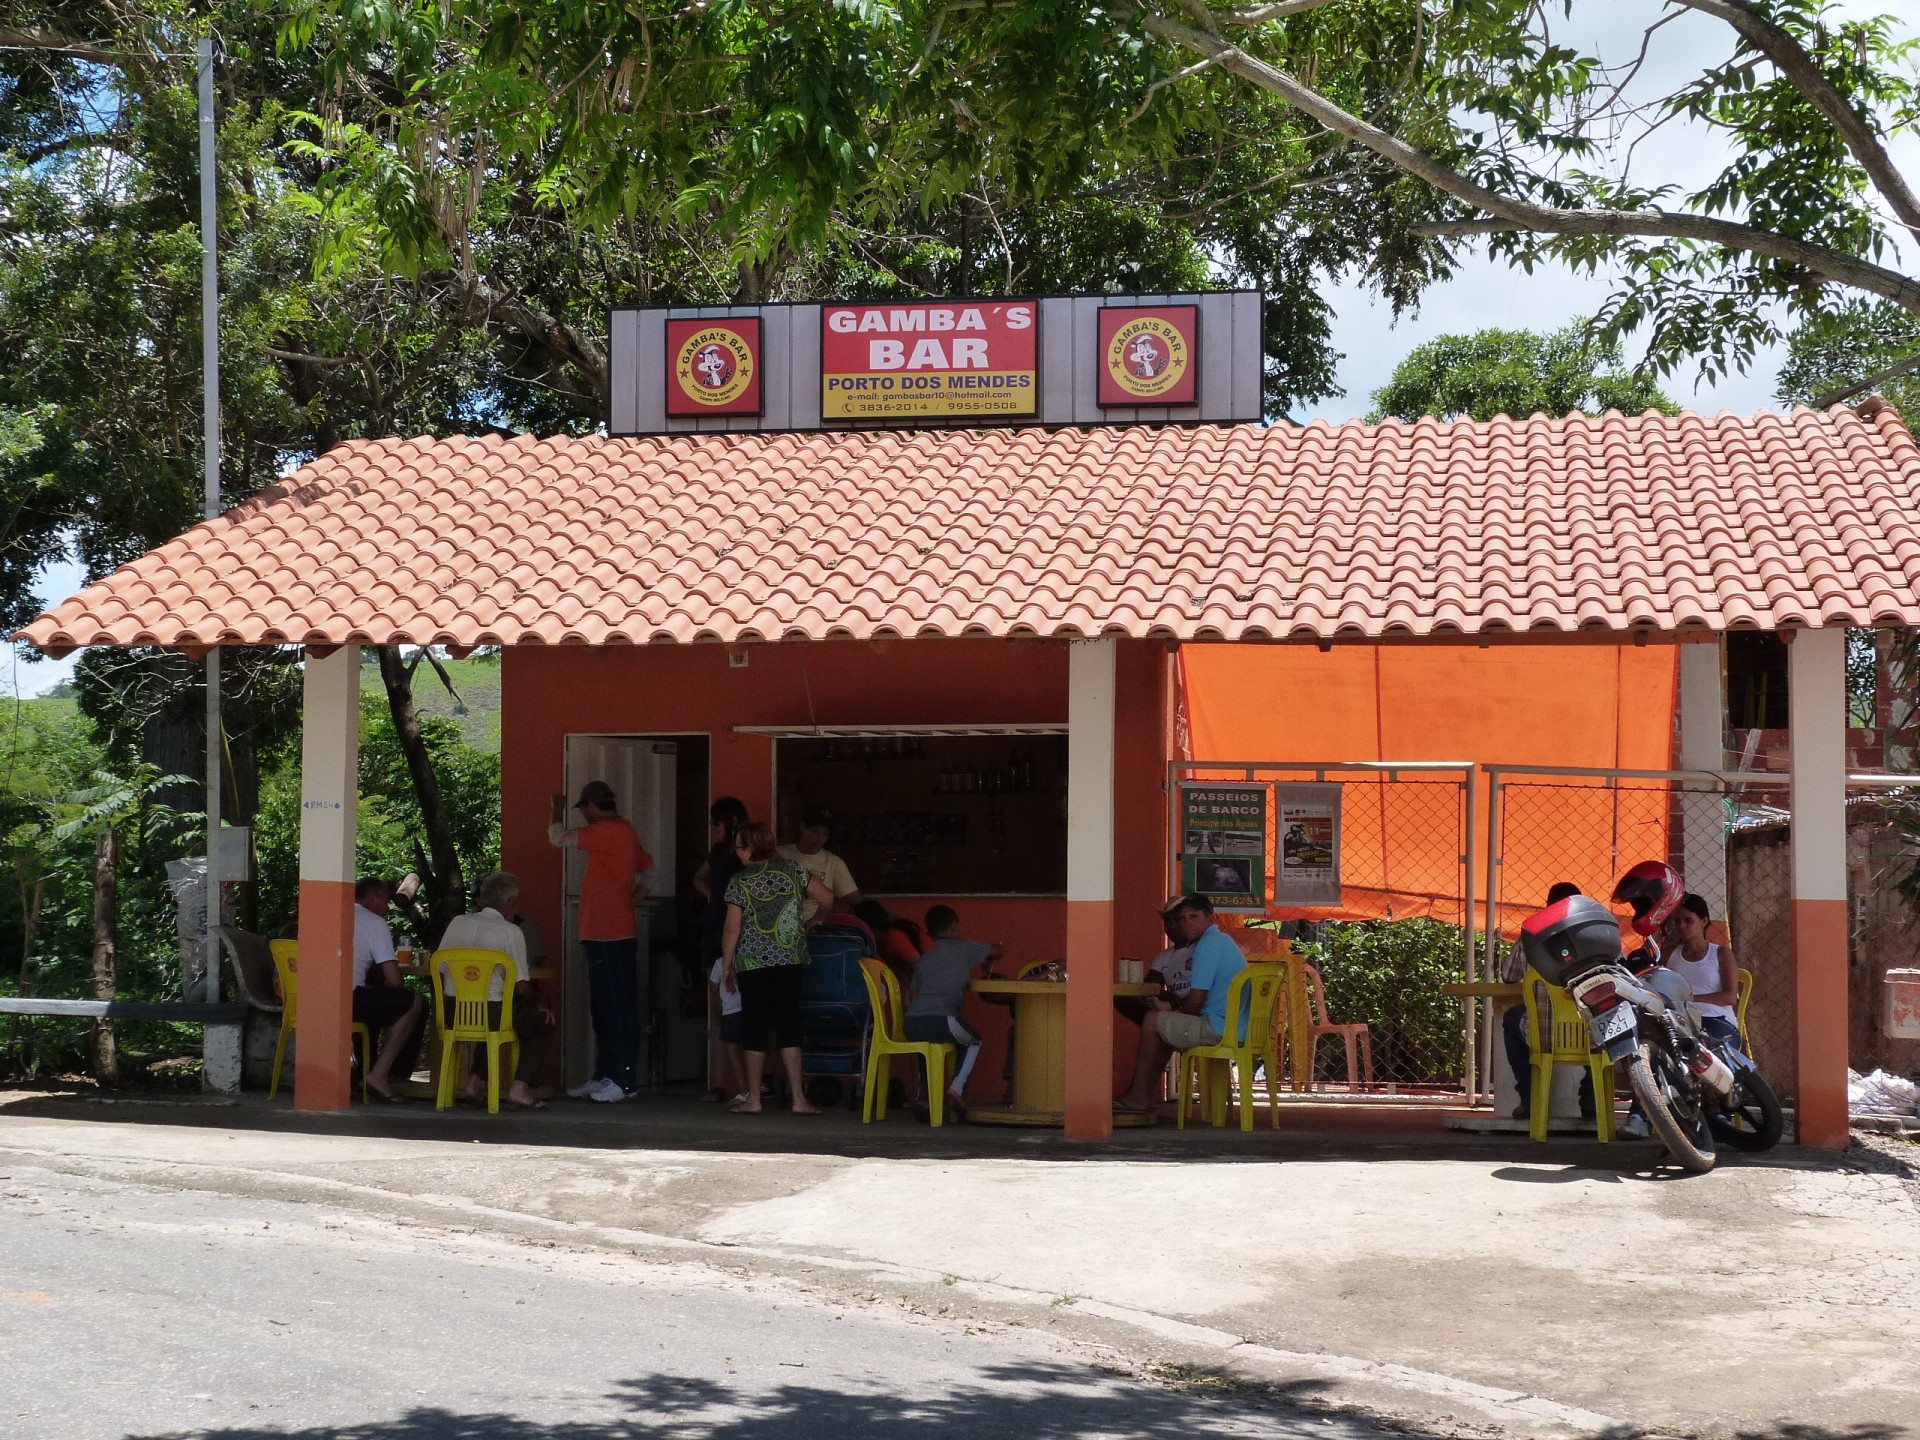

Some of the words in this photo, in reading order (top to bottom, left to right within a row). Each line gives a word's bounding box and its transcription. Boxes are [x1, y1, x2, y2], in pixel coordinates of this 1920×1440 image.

[1113, 322, 1160, 354] GAMBA'S
[1162, 327, 1181, 353] BAR
[682, 332, 727, 364] GAMBA'S
[729, 338, 748, 362] BAR
[869, 338, 990, 370] BAR
[828, 377, 895, 391] PORTO
[901, 376, 941, 390] DOS
[948, 375, 1031, 389] MENDES
[847, 393, 880, 401] e-mail:
[882, 391, 1012, 401] gambasbar10@hotmail.com
[859, 403, 928, 411] 3836-2014
[948, 402, 1017, 410] 9955-0508
[1189, 792, 1259, 802] PASSEIOS
[1189, 805, 1206, 814] DE
[1211, 806, 1260, 815] BARCO
[1208, 896, 1260, 905] 973-6253
